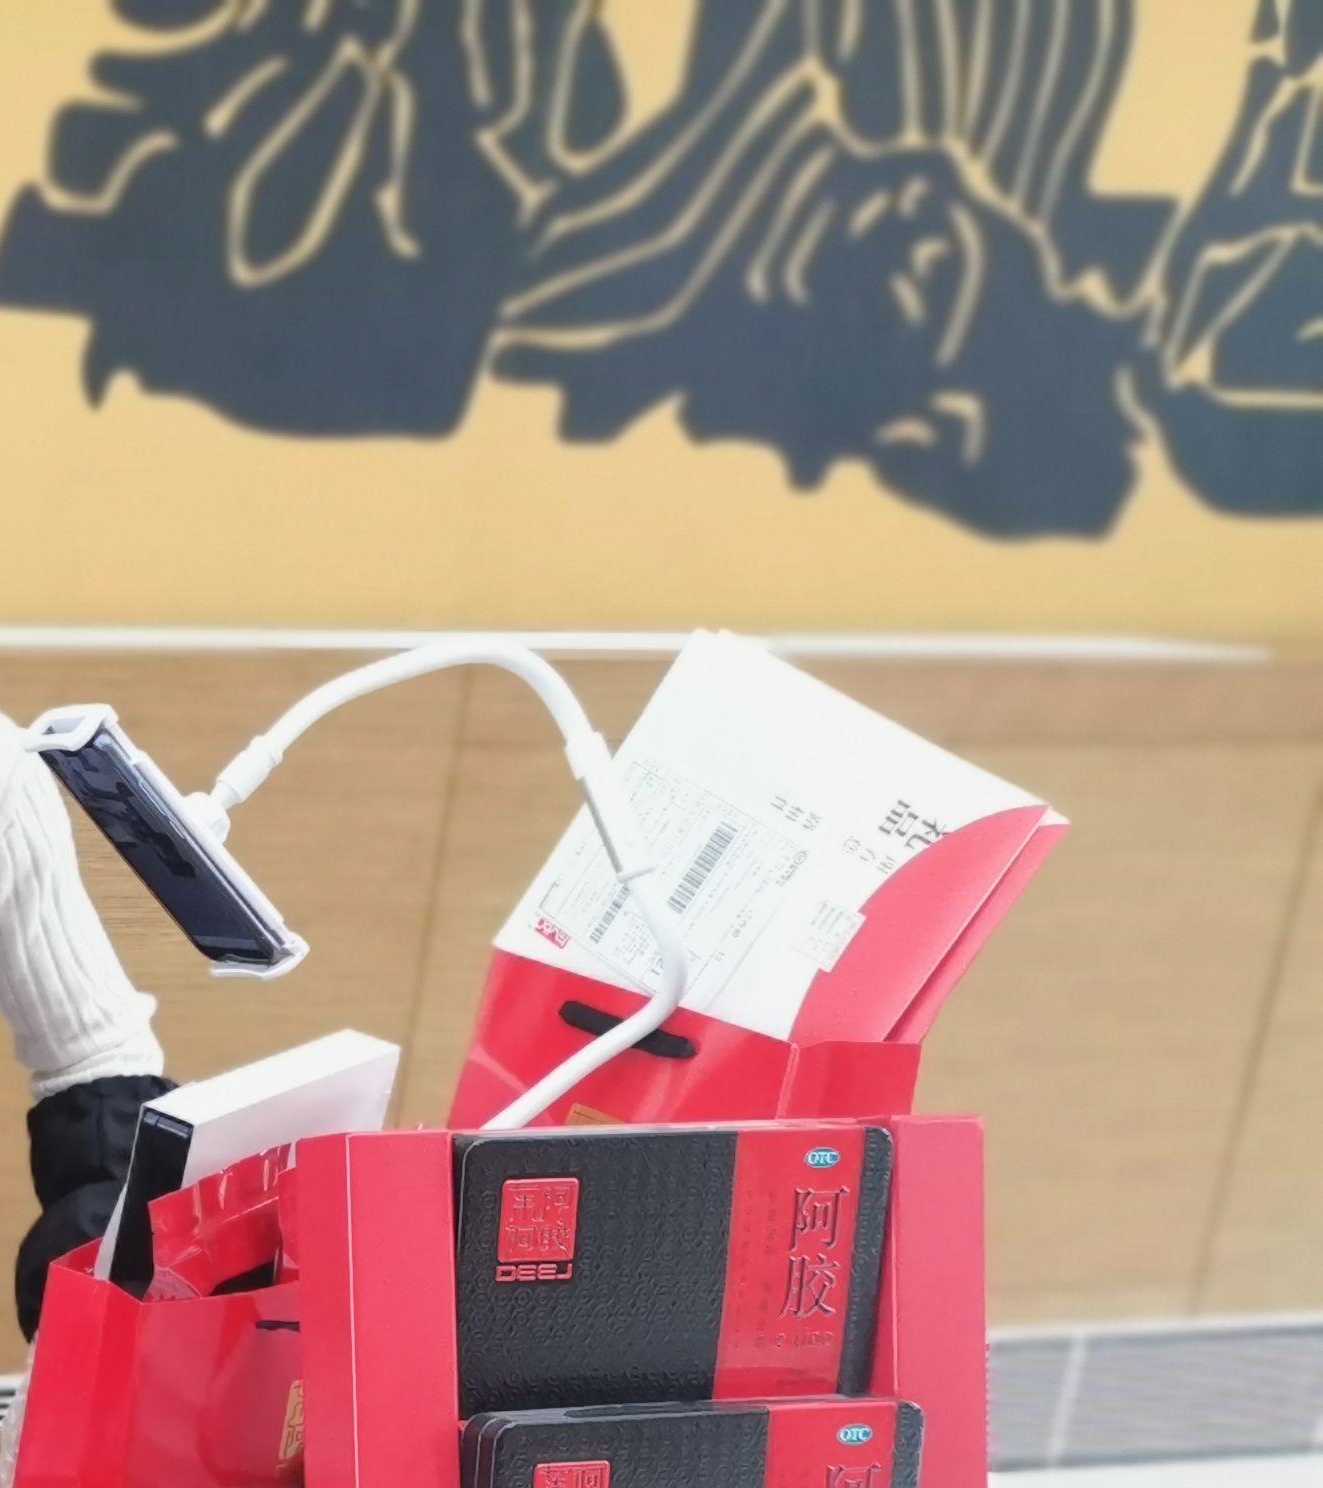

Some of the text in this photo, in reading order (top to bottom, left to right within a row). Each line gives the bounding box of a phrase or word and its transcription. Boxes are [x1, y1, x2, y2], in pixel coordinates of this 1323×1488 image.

[807, 1152, 838, 1165] OTC
[780, 1186, 850, 1319] 阿胶
[495, 1264, 573, 1281] DEEJ
[840, 1428, 870, 1442] OTC
